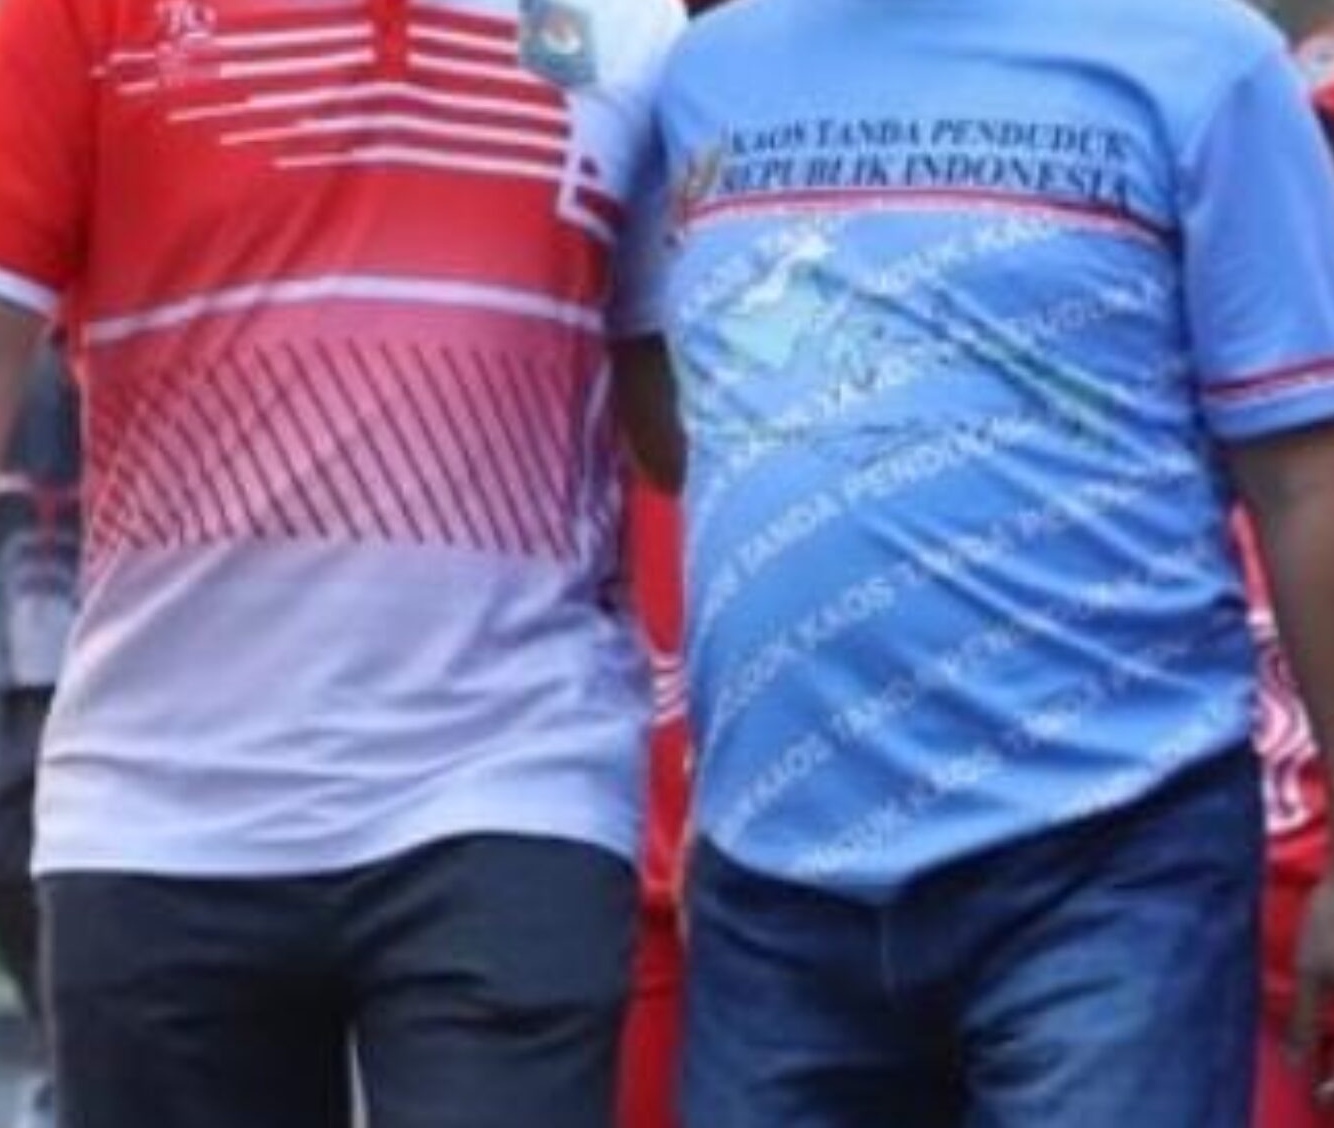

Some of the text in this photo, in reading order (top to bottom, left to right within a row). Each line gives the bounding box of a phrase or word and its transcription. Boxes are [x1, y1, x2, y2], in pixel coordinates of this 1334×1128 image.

[729, 118, 1133, 160] KAOS TANDA PENDUDUK
[719, 153, 1131, 209] REPUBLIK INDONESIA
